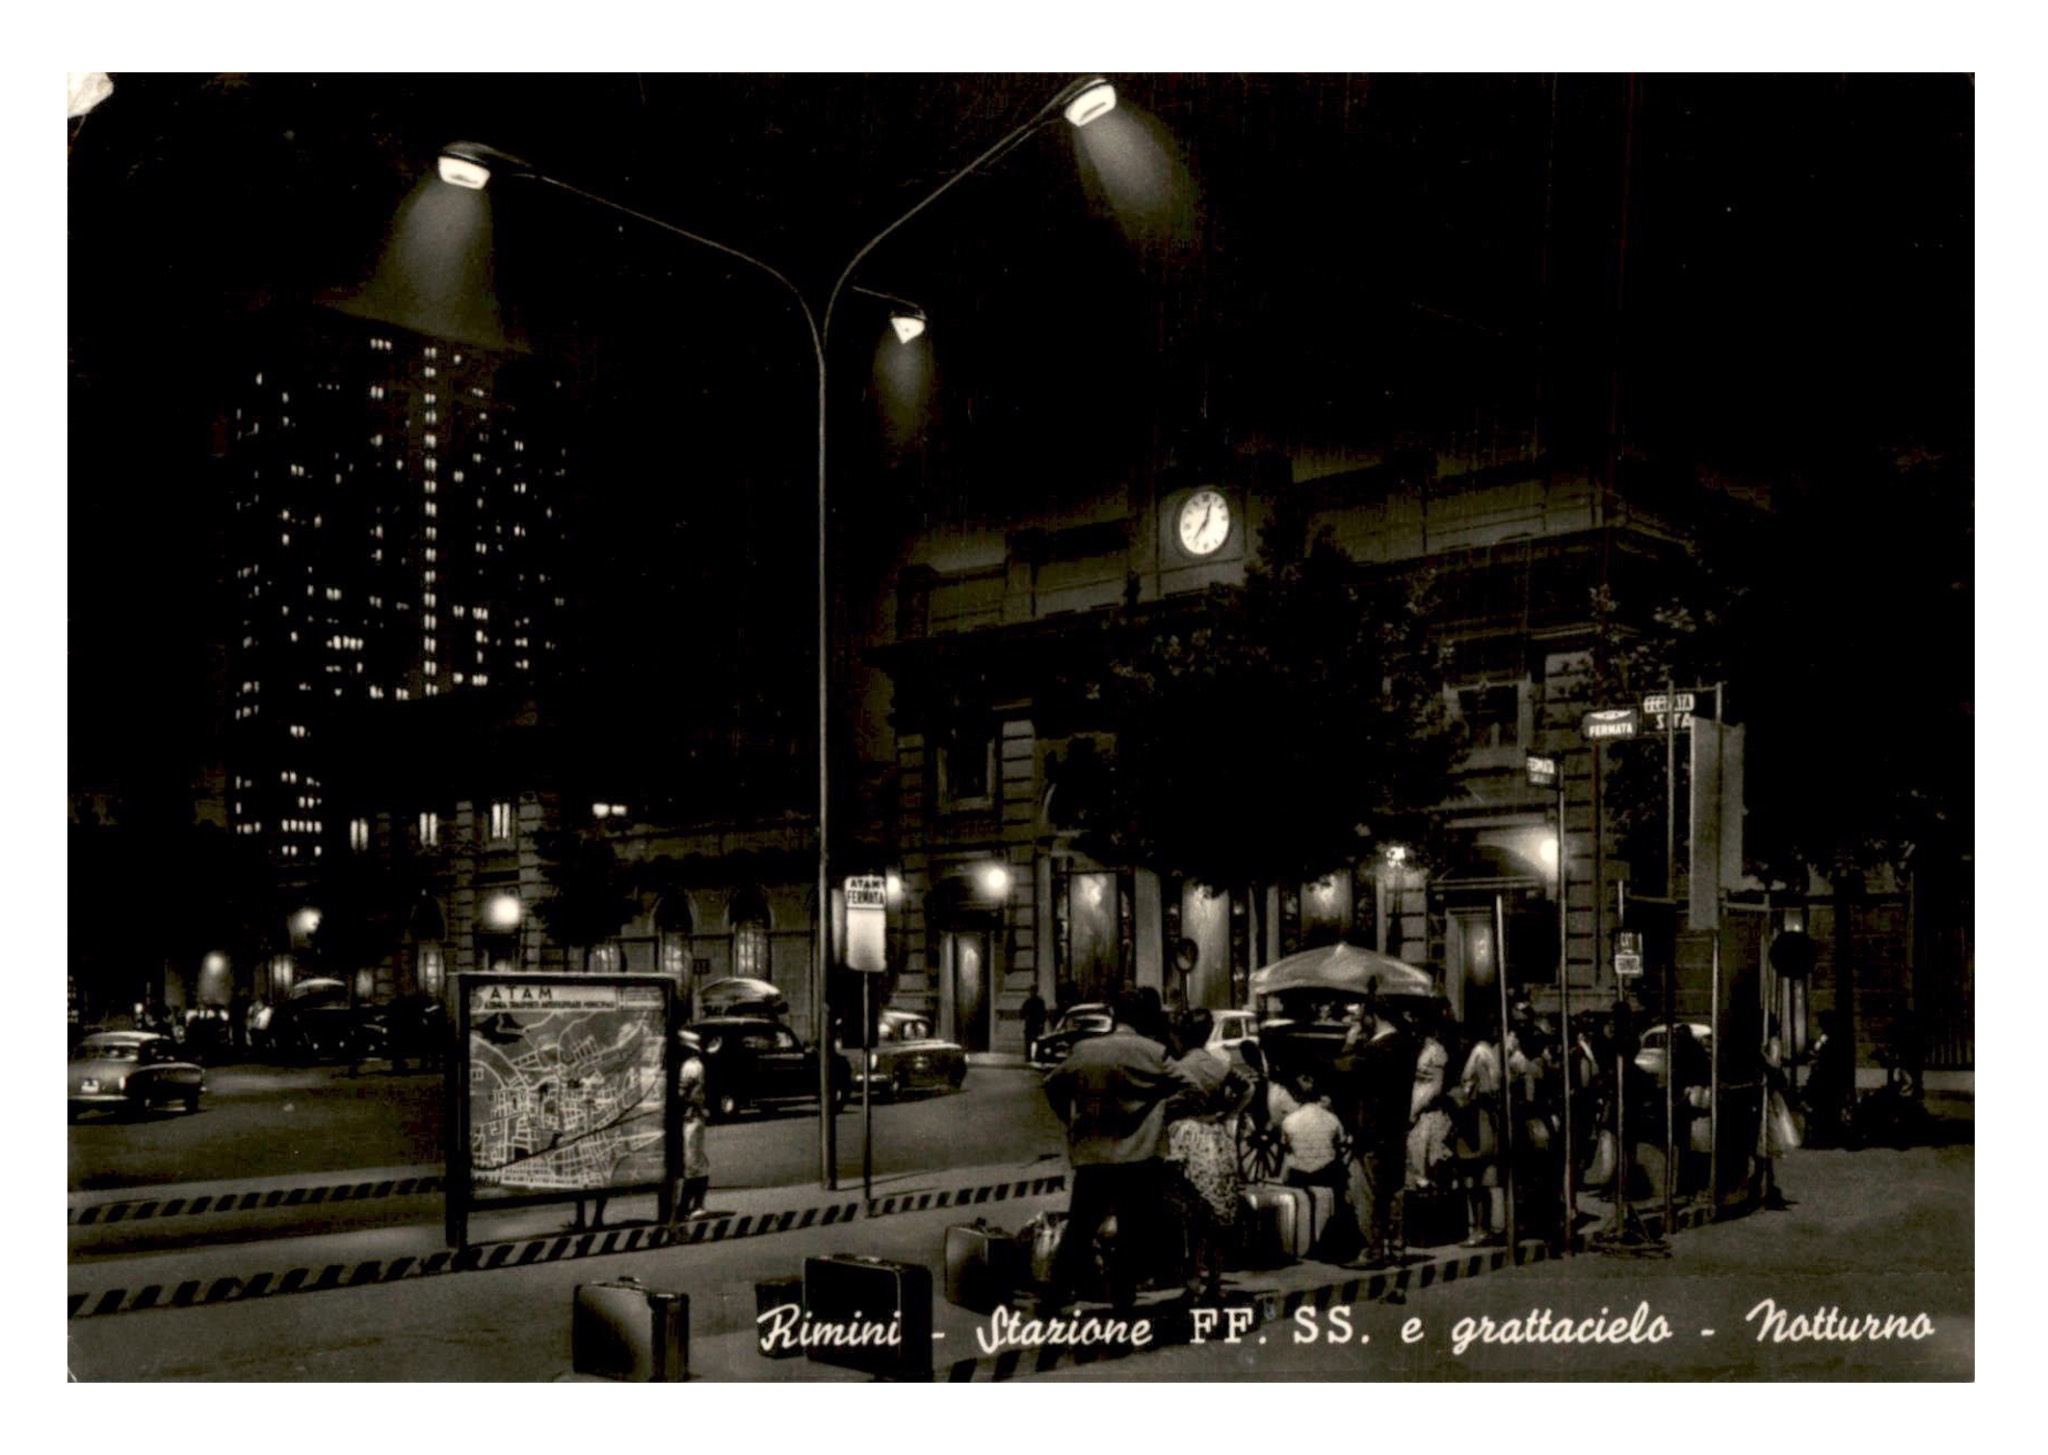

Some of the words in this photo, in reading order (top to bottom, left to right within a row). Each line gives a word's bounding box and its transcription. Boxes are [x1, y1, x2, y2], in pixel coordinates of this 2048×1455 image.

[1655, 713, 1691, 730] STA
[1588, 722, 1634, 738] FERMATA
[850, 879, 881, 889] ATAM
[847, 890, 885, 904] FERMATA
